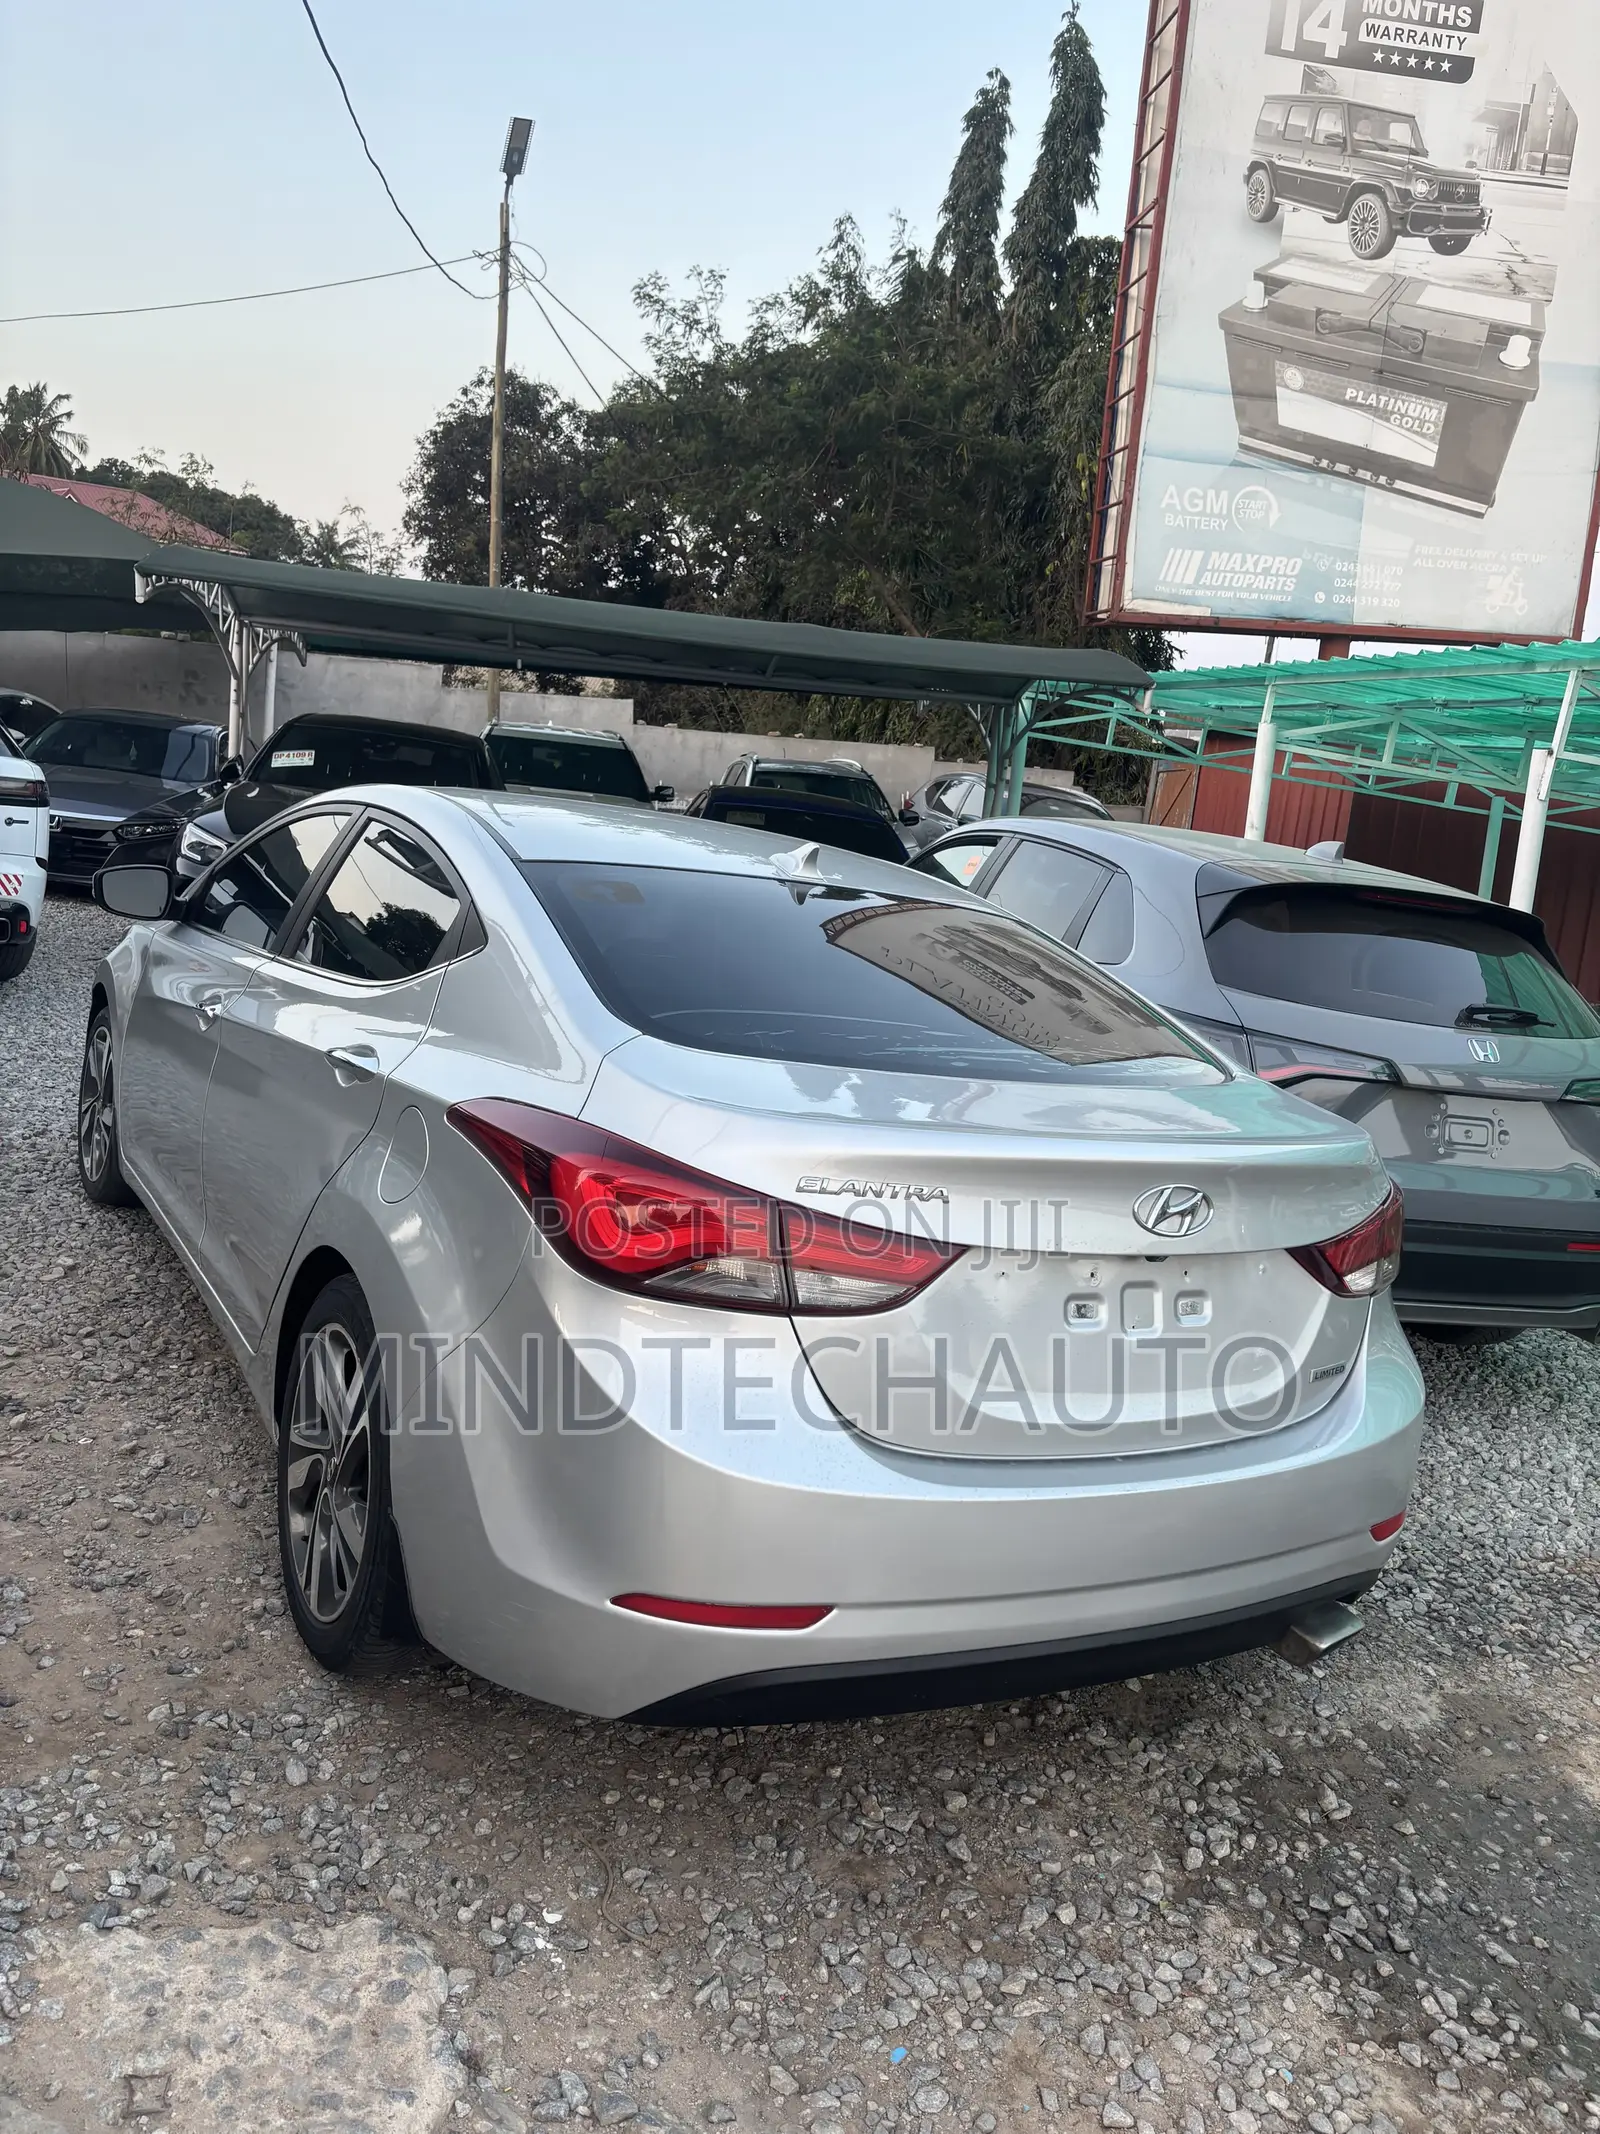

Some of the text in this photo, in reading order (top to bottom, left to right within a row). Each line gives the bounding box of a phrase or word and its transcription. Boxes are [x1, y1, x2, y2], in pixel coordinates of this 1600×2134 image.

[1362, 0, 1473, 28] MONTHS
[1365, 23, 1467, 51] WARRANTY
[1345, 387, 1439, 421] PLATINUM
[1390, 414, 1435, 434] GOLD
[1160, 484, 1229, 515] AGM
[1237, 499, 1268, 510] START
[1165, 513, 1229, 531] BATTERY
[1238, 509, 1265, 520] STOP
[1207, 551, 1303, 576] MAXPRO
[1413, 557, 1508, 573] ALL OVER ACCRA
[1199, 571, 1297, 592] AUTOPARTS
[1178, 588, 1194, 596] THE
[1217, 590, 1234, 598] FOR
[1236, 591, 1259, 600] YOUR
[1260, 593, 1293, 602] VEHICLE
[1360, 596, 1379, 605] 319
[1381, 598, 1400, 608] 320
[795, 1176, 950, 1204] ELANTRA
[1315, 1366, 1345, 1380] LIMITED
